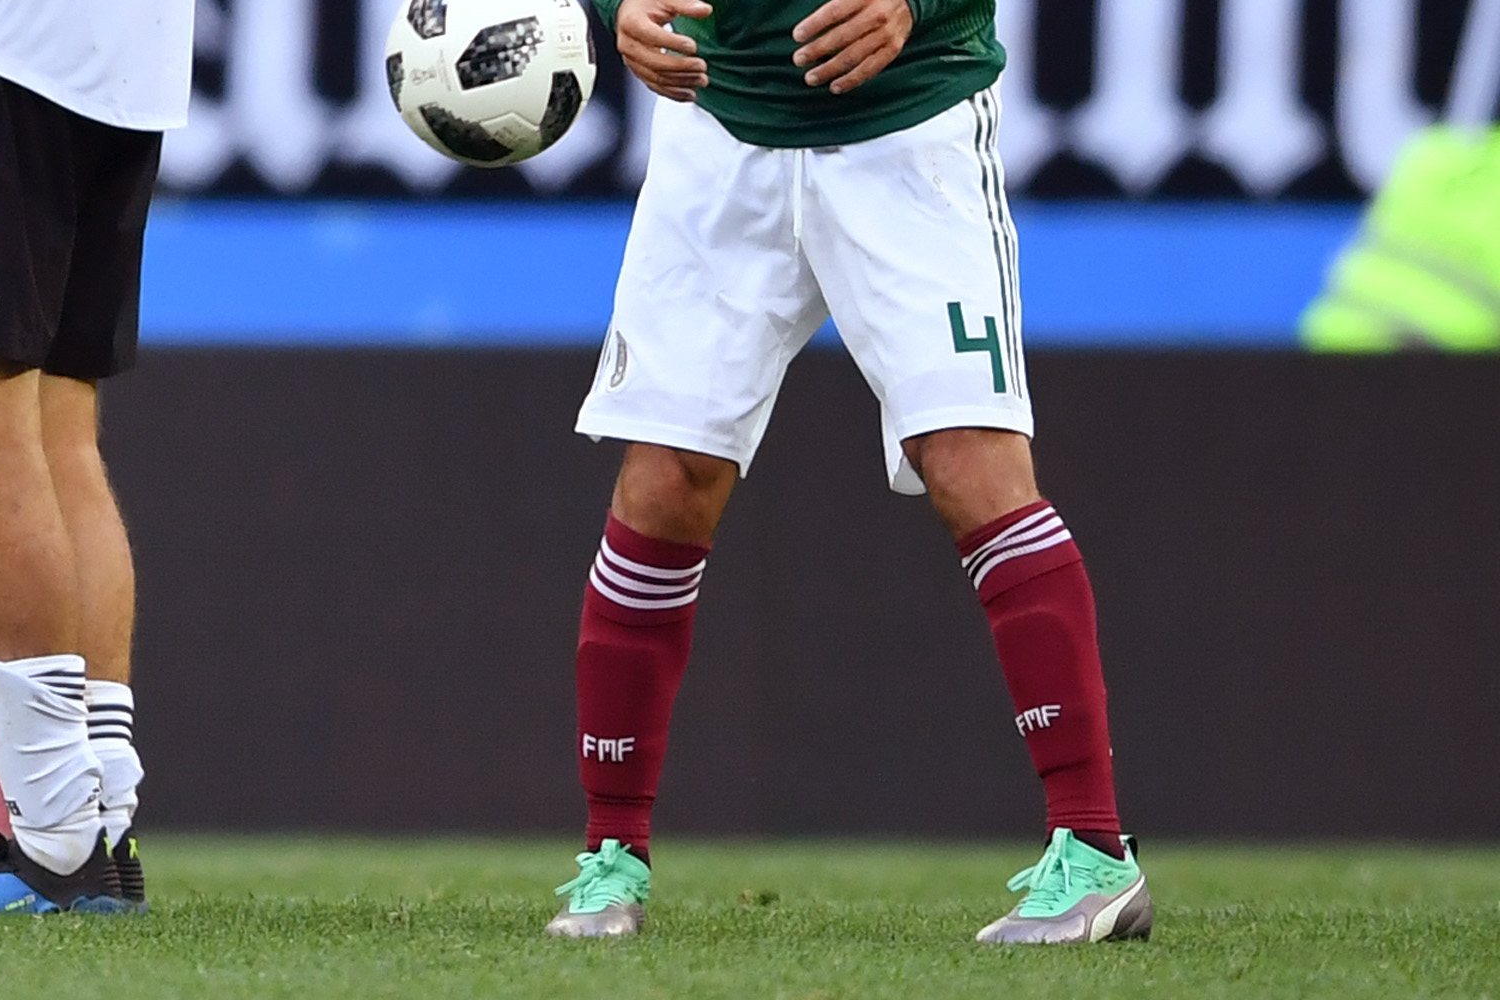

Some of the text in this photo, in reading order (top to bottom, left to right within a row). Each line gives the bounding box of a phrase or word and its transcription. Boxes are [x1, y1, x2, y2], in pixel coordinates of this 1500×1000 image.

[947, 301, 1007, 394] 4
[1013, 704, 1062, 738] FMF
[582, 732, 636, 763] FMF
